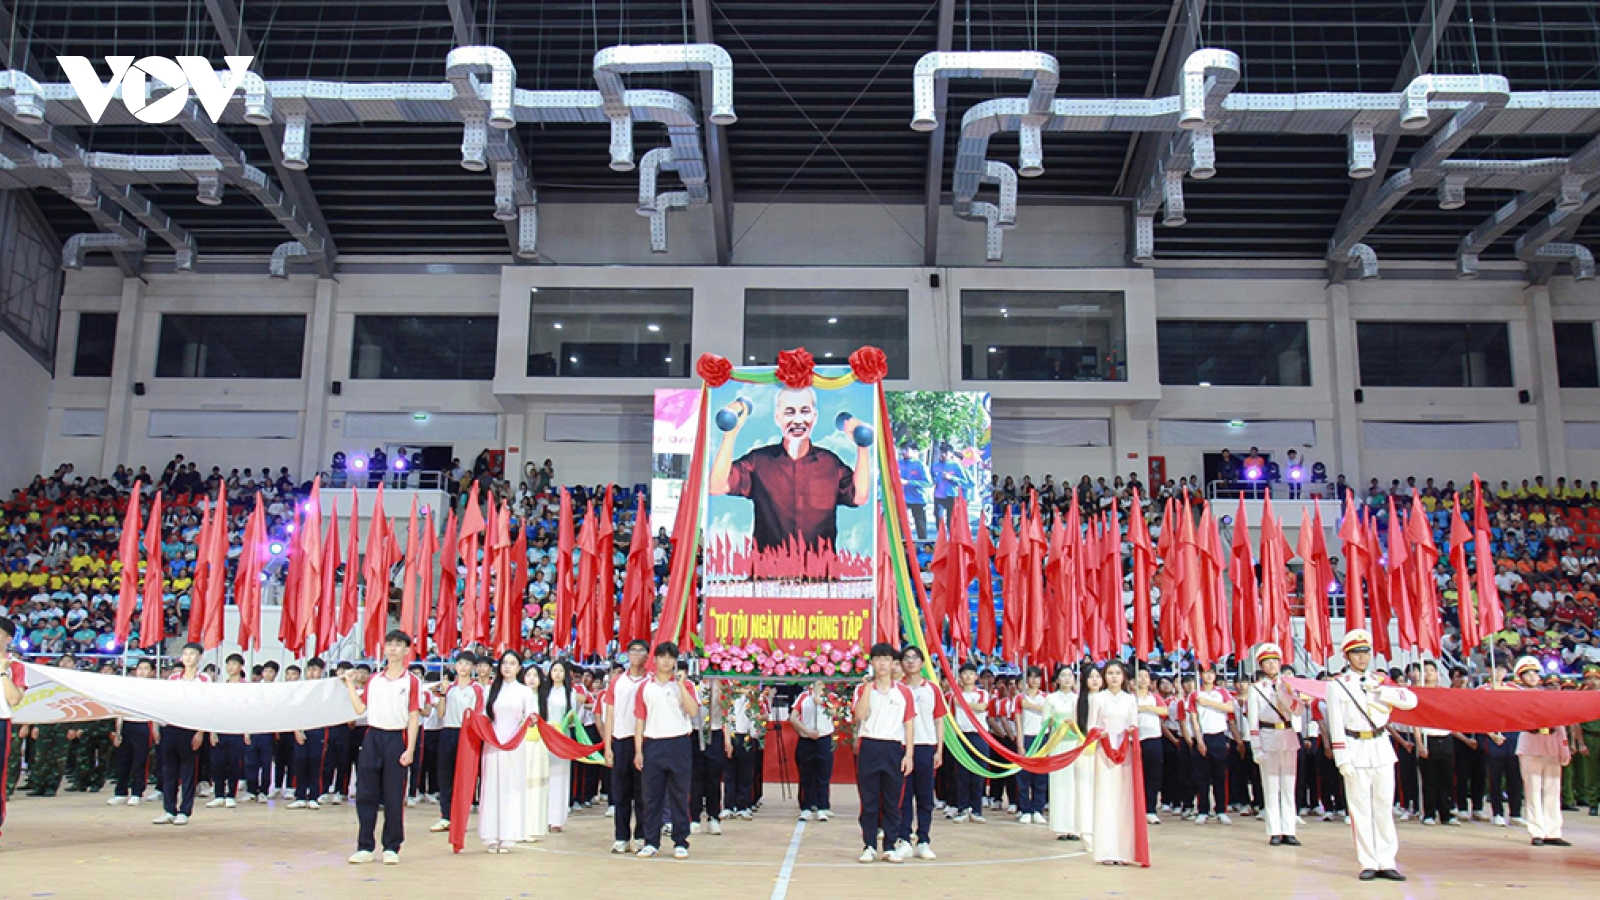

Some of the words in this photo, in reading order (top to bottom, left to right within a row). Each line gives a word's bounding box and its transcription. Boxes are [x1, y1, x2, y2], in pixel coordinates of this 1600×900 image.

[731, 609, 747, 638] TÔI
[751, 609, 780, 639] NGÀY
[783, 609, 806, 639] NÀO
[808, 610, 839, 640] CŨNG
